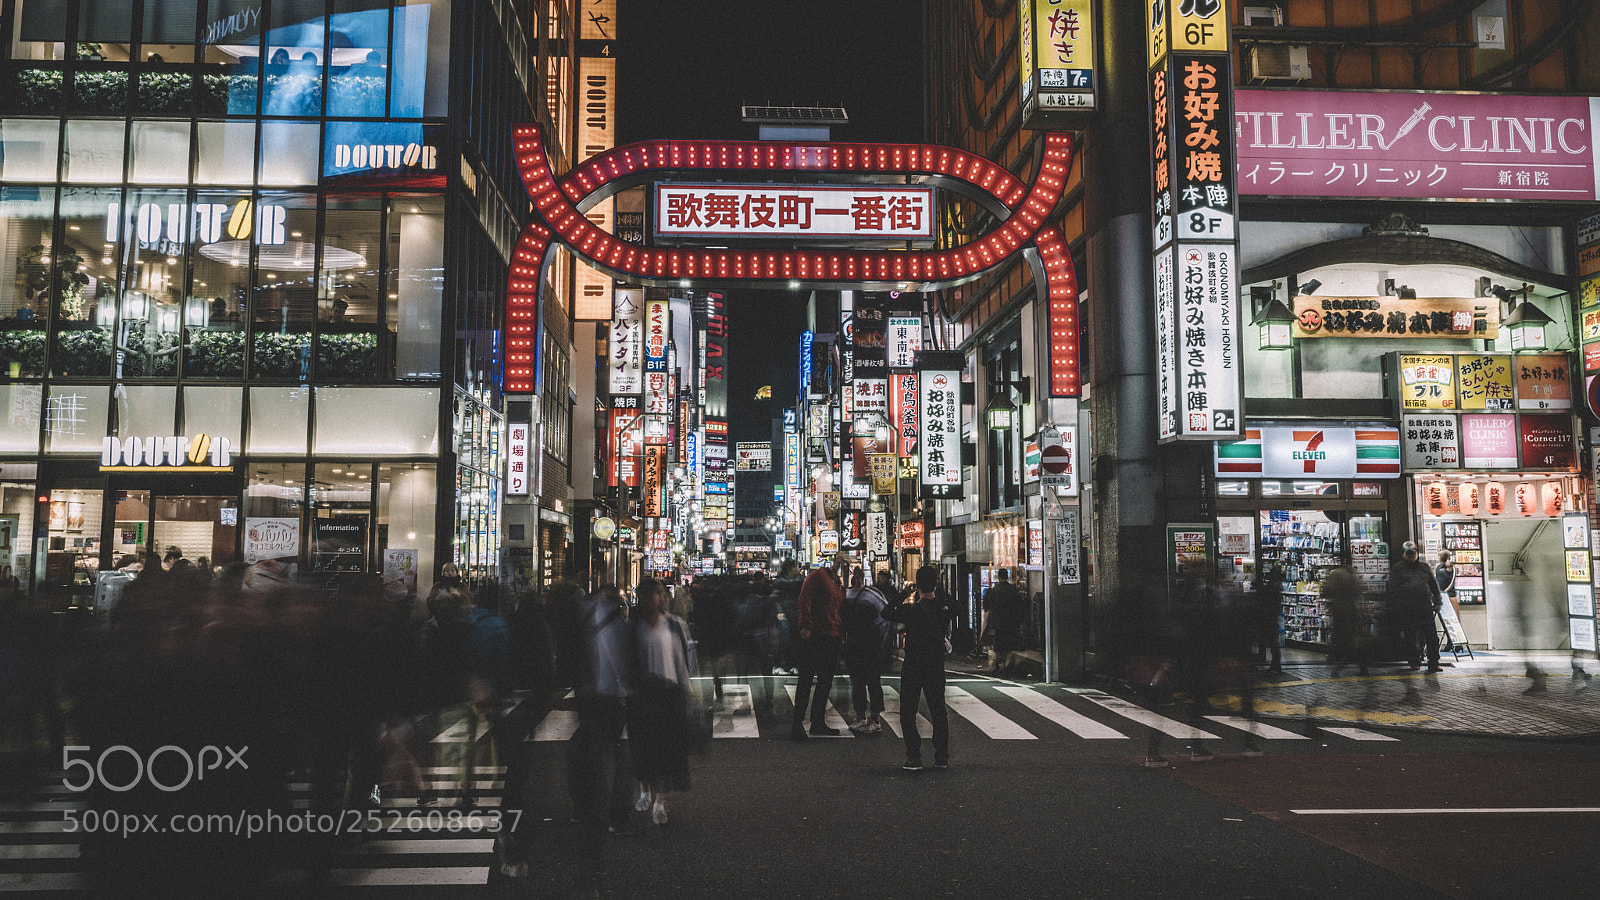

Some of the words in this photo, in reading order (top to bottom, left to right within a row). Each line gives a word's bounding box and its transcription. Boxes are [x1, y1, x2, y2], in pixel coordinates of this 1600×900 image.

[1185, 23, 1214, 45] 6F
[602, 45, 610, 56] 4
[1154, 29, 1163, 57] 6F
[1070, 70, 1088, 87] 7F
[1046, 94, 1086, 106] 小松ビル
[1183, 60, 1223, 183] お好み焼
[1153, 70, 1168, 194] お好み焼
[1428, 116, 1587, 155] CLINIC
[336, 144, 437, 169] DOUTOR
[1324, 162, 1448, 187] クリニック
[1497, 170, 1550, 186] 新宿院
[1182, 185, 1228, 207] 本陣
[667, 193, 923, 230] 歌舞伎町一番街
[1159, 221, 1170, 242] 8F
[1189, 213, 1222, 234] 8F
[1207, 252, 1218, 304] 歌舞伎町名物
[1219, 252, 1231, 327] OKONOMIYAKI
[614, 319, 630, 373] バンタイ
[896, 327, 908, 366] 東南荘
[1184, 266, 1208, 413] お好み焼き本陣
[1222, 328, 1232, 370] HONJIN
[647, 360, 666, 370] B1F
[1416, 366, 1438, 380] 麻雀
[1460, 356, 1494, 375] お好み
[1461, 366, 1505, 387] もんじゃ
[1521, 366, 1565, 381] お好み焼
[855, 381, 886, 396] 焼肉
[1414, 384, 1441, 398] ブル
[1460, 380, 1513, 401] たこ焼き
[614, 396, 632, 408] 焼肉
[1404, 399, 1427, 408] 新宿店
[1441, 399, 1454, 408] 6F
[1501, 399, 1513, 409] 7F
[1538, 401, 1549, 409] 8F
[901, 376, 917, 456] 焼鳥釜めし
[1213, 412, 1234, 428] 2F
[1469, 418, 1507, 429] FILLER
[926, 388, 946, 478] お好み焼本陣
[1407, 428, 1455, 441] お好み焼
[1469, 430, 1508, 440] CLINIC
[1527, 434, 1557, 442] Corner
[1558, 434, 1572, 442] 117
[102, 433, 231, 467] DOUTOR
[1293, 430, 1323, 473] 7
[1416, 441, 1441, 453] 本陣
[512, 428, 525, 489] 劇場通り
[1425, 456, 1439, 466] 2F
[1484, 459, 1496, 467] 3F
[1543, 456, 1555, 464] 4F
[901, 468, 918, 478] 2F
[932, 485, 949, 494] 2F
[261, 529, 292, 542] パリパリ
[319, 523, 359, 532] information
[1351, 544, 1374, 555] たばこ
[1376, 544, 1387, 555] 酒
